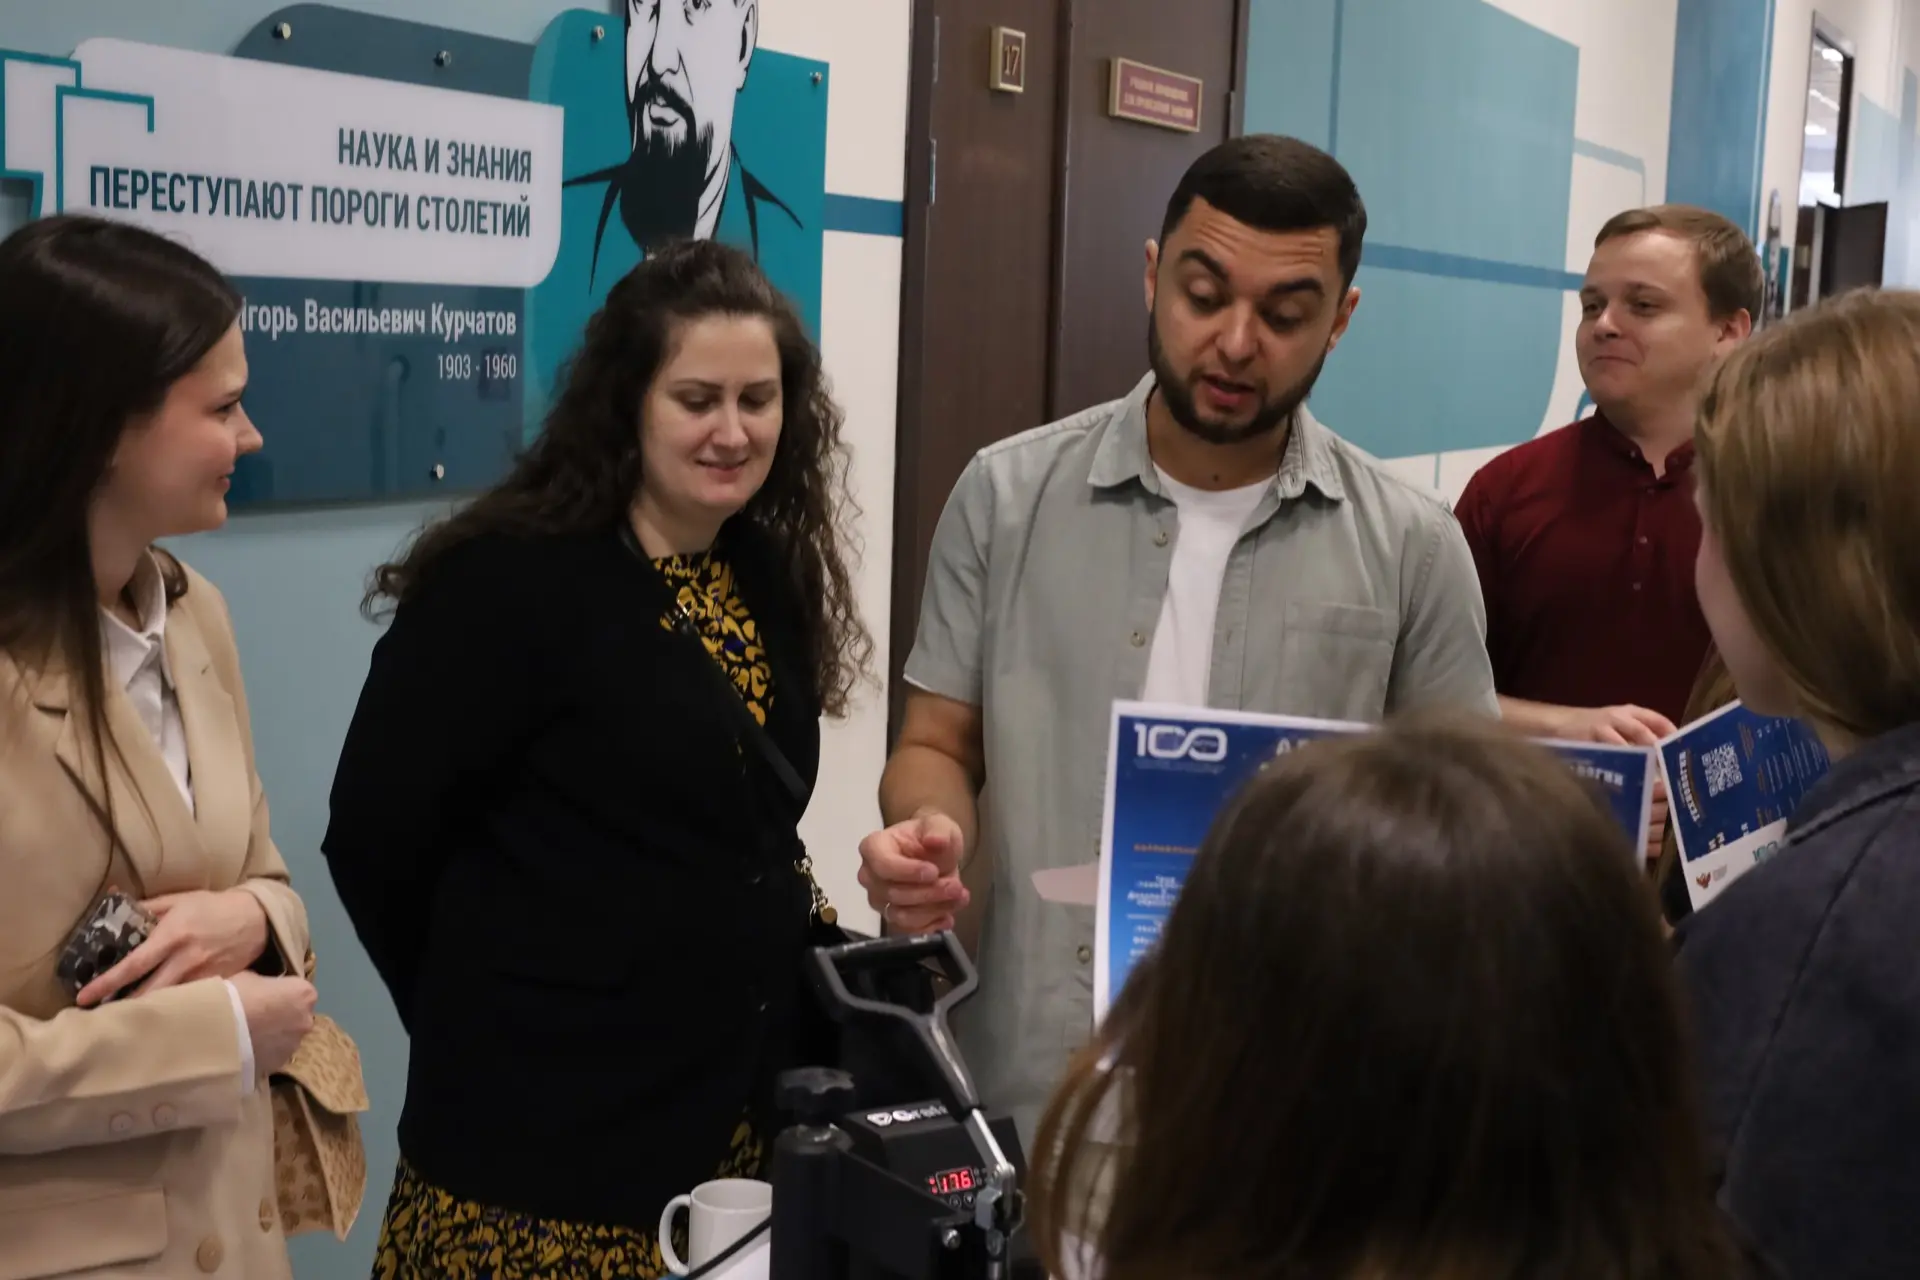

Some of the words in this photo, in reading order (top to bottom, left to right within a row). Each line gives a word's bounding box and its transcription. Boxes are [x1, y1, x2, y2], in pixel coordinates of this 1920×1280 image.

[1004, 45, 1020, 76] 17
[338, 127, 418, 172] НАУКА
[424, 137, 440, 174] И
[446, 140, 532, 184] ЗНАНИЯ
[90, 165, 304, 222] ПЕРЕСТУПАЮТ
[311, 185, 409, 230] ПОРОГИ
[416, 194, 531, 238] СТОЛЕТИЙ
[304, 297, 426, 335] Васильевич
[431, 302, 517, 343] Курчатов
[438, 353, 472, 380] 1903
[484, 354, 517, 379] 1960
[942, 1169, 973, 1193] 176
